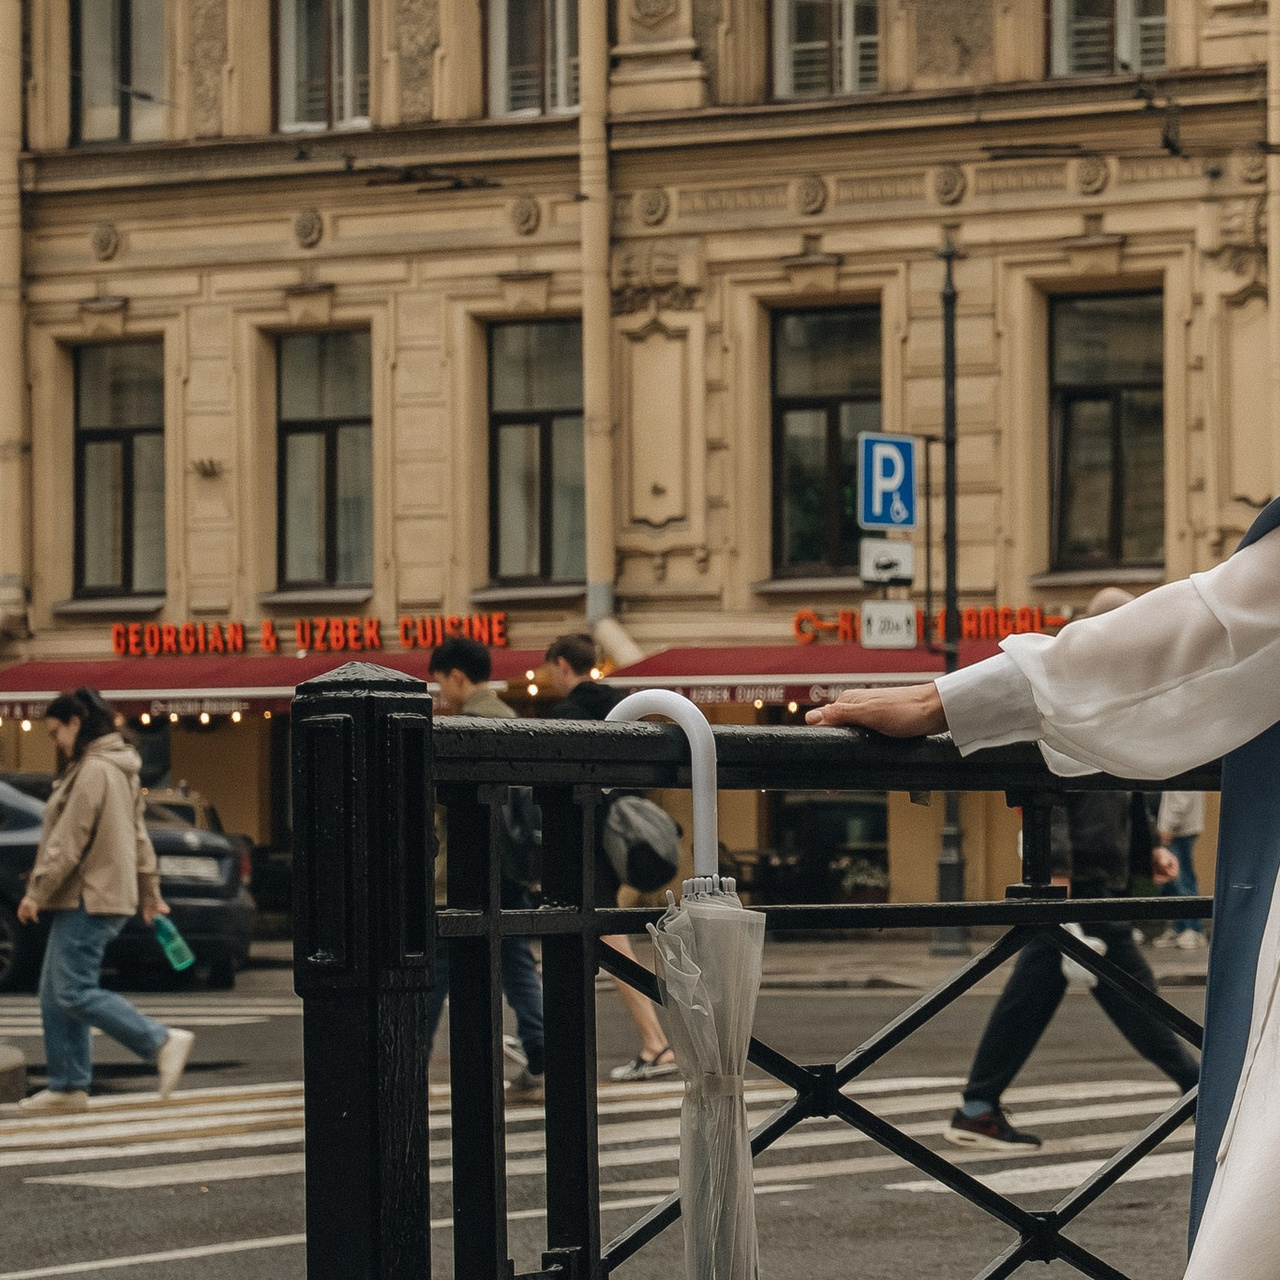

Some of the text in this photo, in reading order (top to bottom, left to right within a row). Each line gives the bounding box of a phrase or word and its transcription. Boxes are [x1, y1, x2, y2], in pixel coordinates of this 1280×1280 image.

[871, 442, 906, 517] P
[111, 611, 506, 655] GEORGIAN & UZBEK CUISINE
[937, 605, 1044, 638] ANGAL
